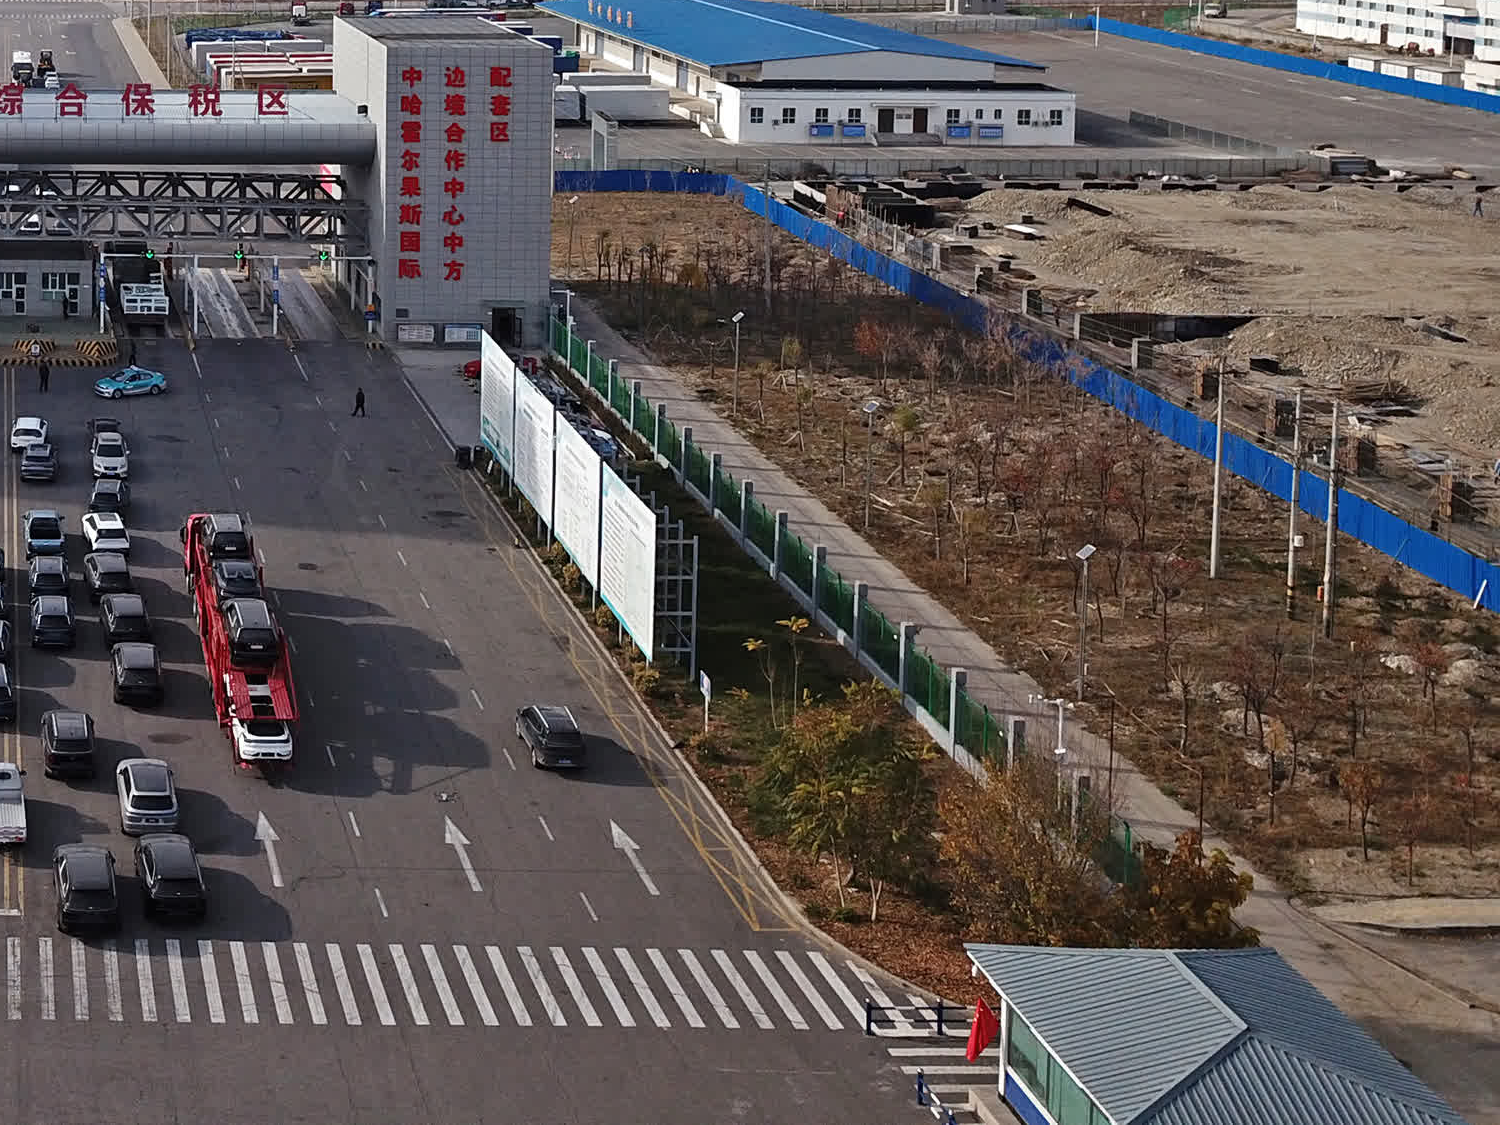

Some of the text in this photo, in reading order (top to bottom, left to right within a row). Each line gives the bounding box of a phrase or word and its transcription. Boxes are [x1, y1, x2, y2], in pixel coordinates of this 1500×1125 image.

[398, 66, 423, 279] 中哈霍尔果斯国际
[442, 66, 467, 281] 边境合作中心中方
[489, 66, 513, 143] 配套区
